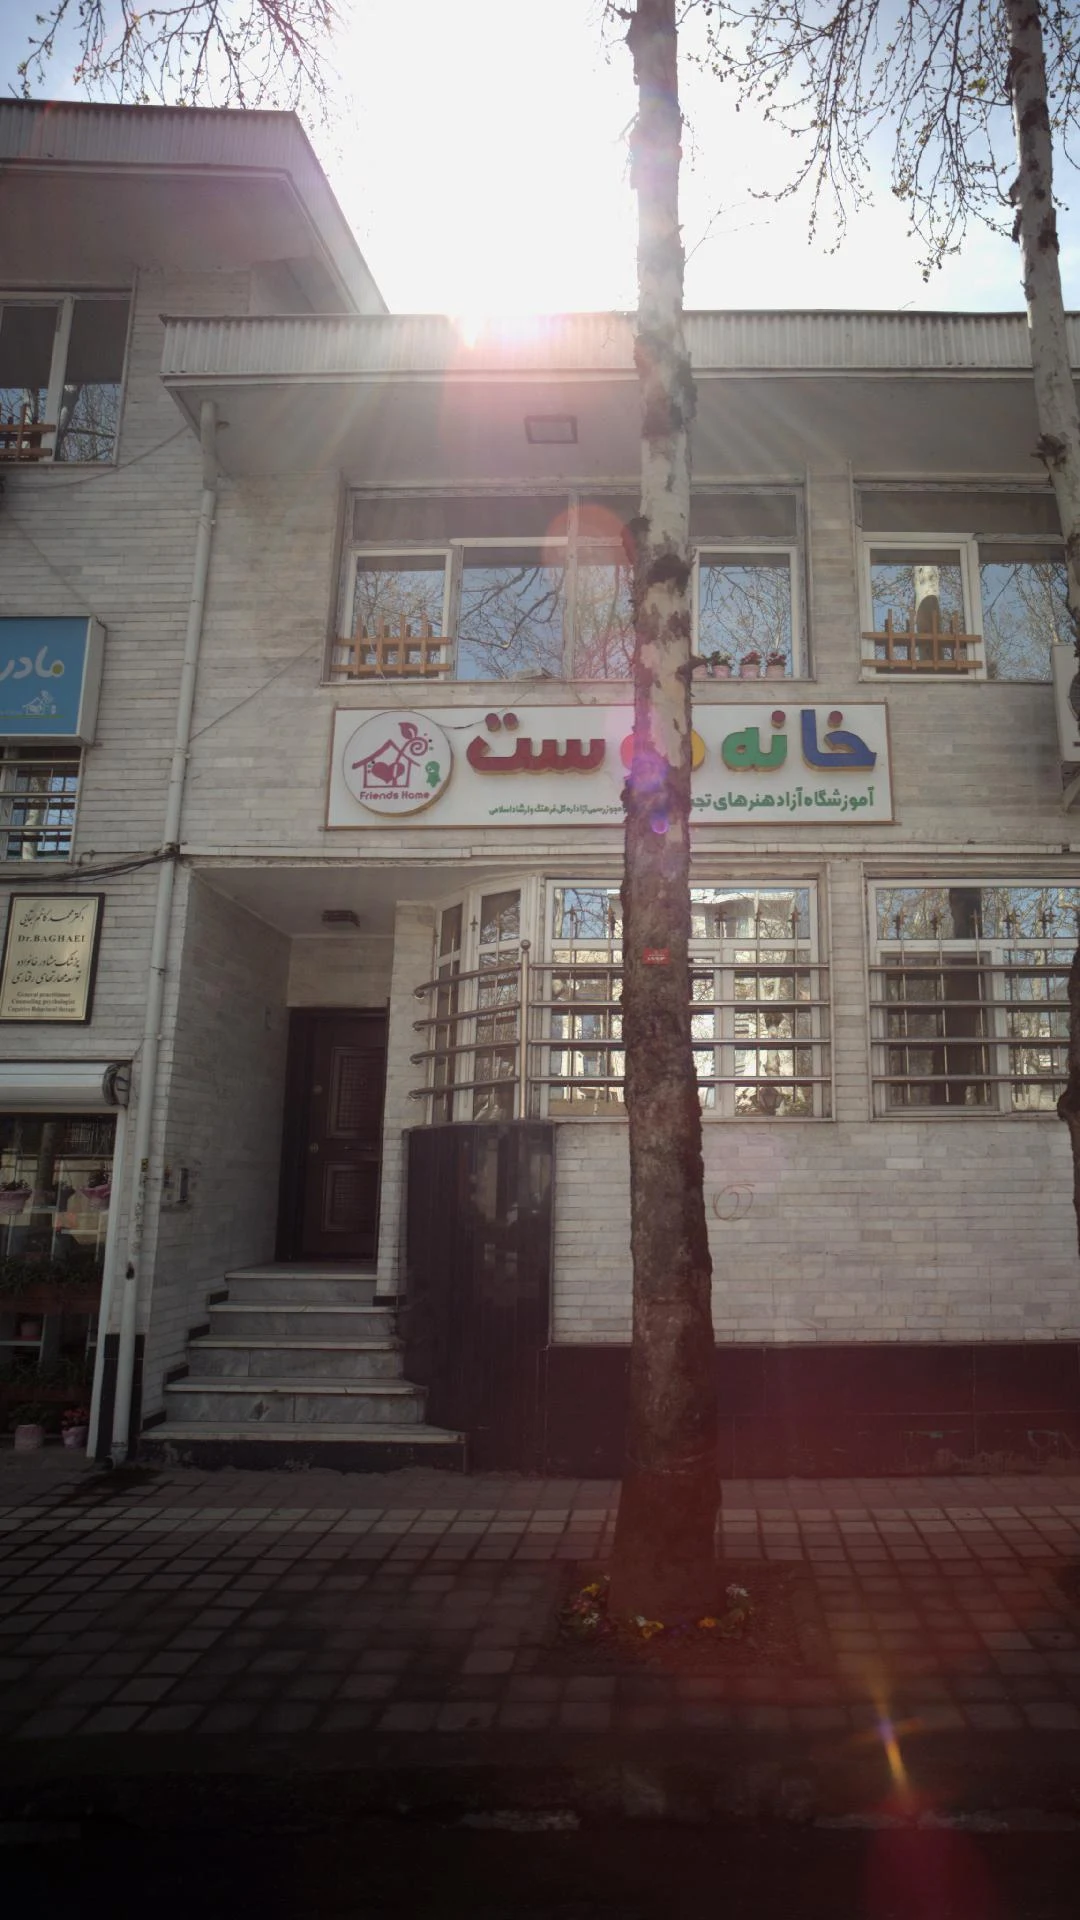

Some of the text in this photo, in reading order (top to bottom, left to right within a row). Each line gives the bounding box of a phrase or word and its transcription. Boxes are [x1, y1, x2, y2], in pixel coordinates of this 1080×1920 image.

[721, 709, 878, 773] خانه
[360, 791, 430, 800] Friends Home
[713, 791, 775, 812] هنرهای
[776, 786, 804, 812] آزاد
[805, 786, 875, 812] آموزشگاه
[488, 804, 512, 816] اسلامی
[534, 804, 556, 816] فرهنگ
